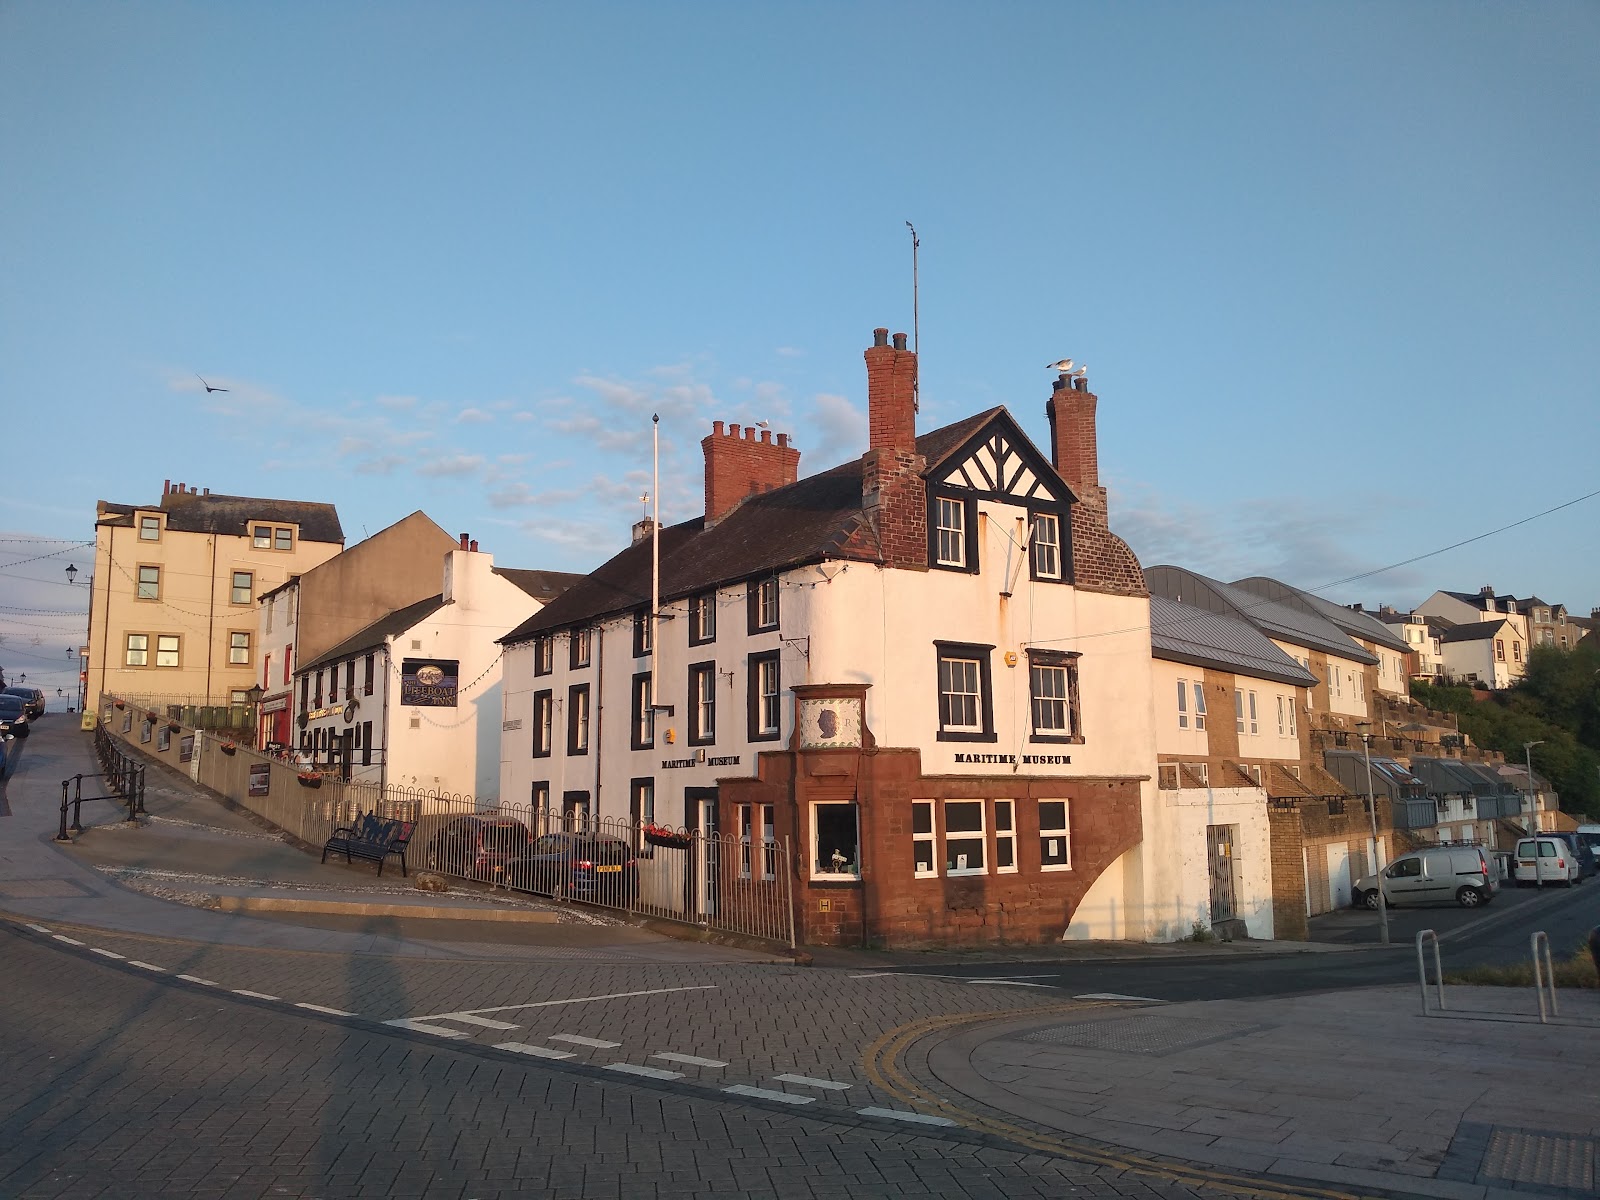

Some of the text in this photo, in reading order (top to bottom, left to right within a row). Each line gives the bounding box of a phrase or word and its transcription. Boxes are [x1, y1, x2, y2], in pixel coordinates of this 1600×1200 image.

[432, 697, 453, 705] INN
[661, 756, 740, 769] MARITIME MUSEUM
[954, 753, 1072, 765] MARITIME MUSEUM
